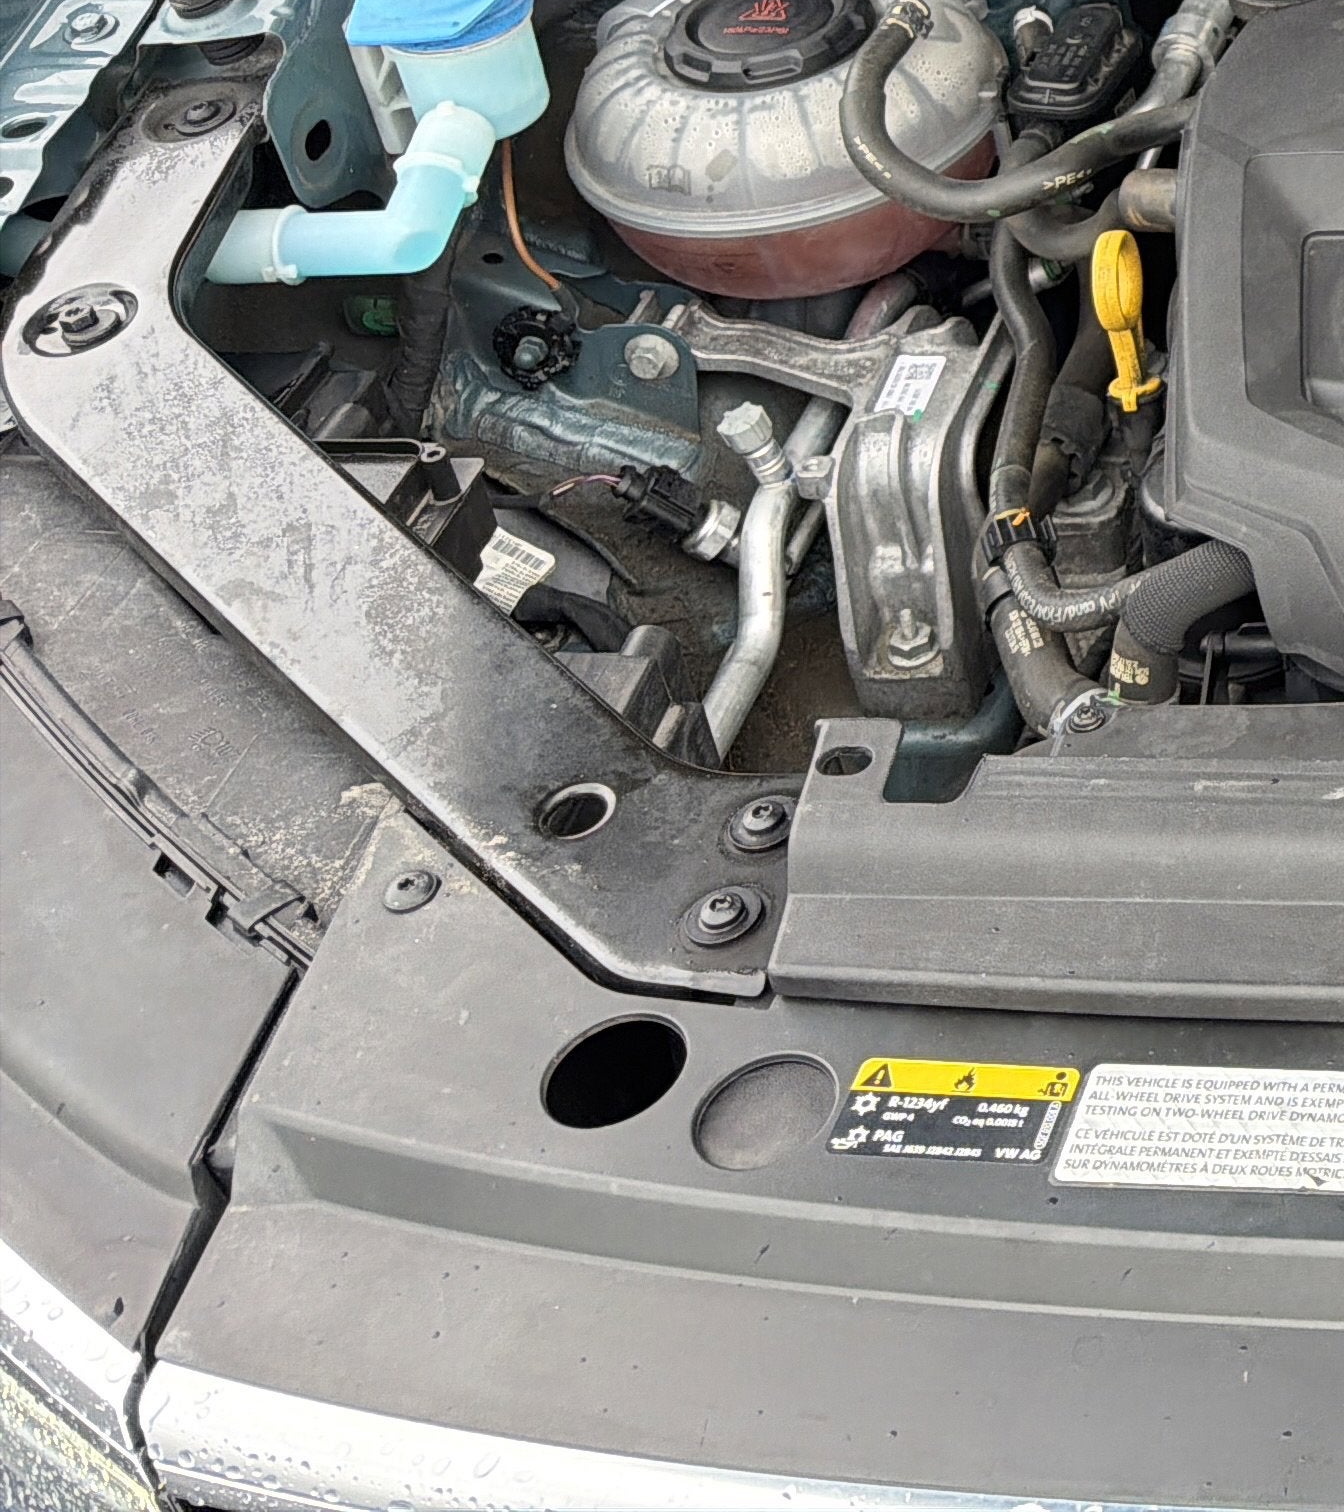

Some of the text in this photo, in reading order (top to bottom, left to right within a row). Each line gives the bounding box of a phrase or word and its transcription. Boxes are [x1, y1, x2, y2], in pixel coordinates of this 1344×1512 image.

[1095, 1076, 1124, 1086] THIS
[1126, 1077, 1180, 1088] VEHICLE
[1180, 1078, 1193, 1089] IS
[1194, 1079, 1260, 1090] EQUIPPED
[1263, 1081, 1298, 1092] WITH
[1299, 1082, 1309, 1092] A
[888, 1096, 950, 1115] R-1234yf
[1014, 1105, 1031, 1117] kg
[1087, 1091, 1159, 1102] ALL-WHEEL
[1162, 1093, 1202, 1104] DRIVE
[1203, 1094, 1252, 1105] SYSTEM
[1253, 1096, 1284, 1106] AND
[1285, 1097, 1298, 1107] IS
[1084, 1105, 1138, 1117] TESTING
[1140, 1107, 1162, 1117] ON
[1164, 1108, 1244, 1120] TWO-WHEEL
[1247, 1110, 1287, 1121] DRIVE
[872, 1129, 905, 1143] PAG
[1074, 1128, 1093, 1139] CE
[1094, 1129, 1156, 1141] VÉHICULE
[1156, 1131, 1180, 1142] EST
[1180, 1132, 1216, 1143] DOTÉ
[1216, 1133, 1252, 1144] D'UN
[1308, 1137, 1327, 1147] DE
[994, 1147, 1019, 1159] VW
[1020, 1149, 1042, 1161] AG
[1068, 1143, 1137, 1156] INTÉGRALE
[1137, 1146, 1216, 1158] PERMANENT
[1214, 1148, 1232, 1159] ET
[1232, 1149, 1288, 1161] EXEMPTÉ
[1288, 1151, 1343, 1163] D'ESSAIS
[1062, 1159, 1090, 1169] SUR
[1198, 1163, 1208, 1173] À
[1210, 1164, 1248, 1175] DEUX
[1249, 1165, 1293, 1177] ROUES
